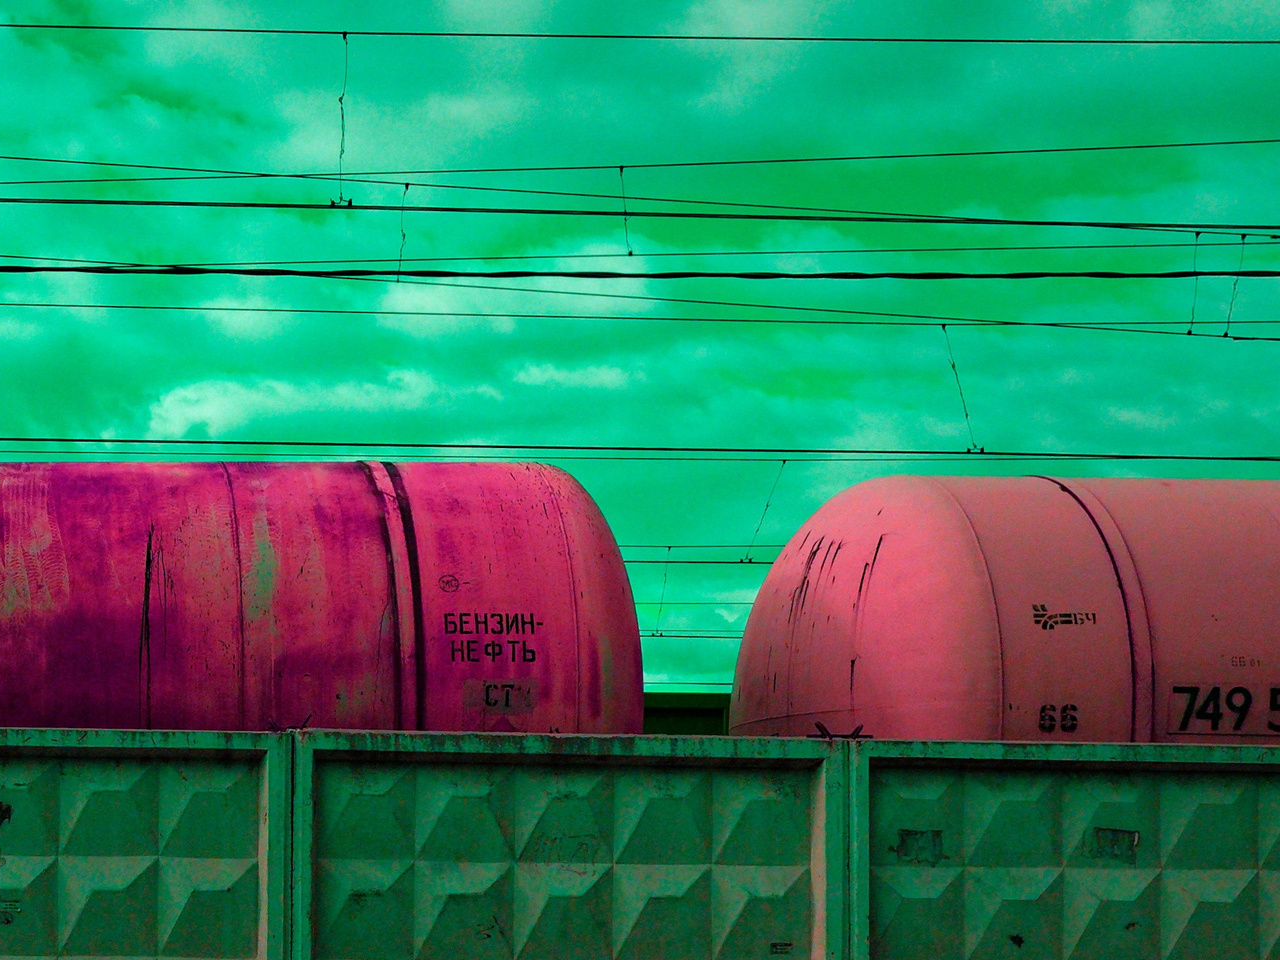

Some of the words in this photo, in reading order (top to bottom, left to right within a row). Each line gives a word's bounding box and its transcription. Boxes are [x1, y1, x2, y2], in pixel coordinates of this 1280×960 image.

[444, 612, 544, 635] БЕНЗИН-
[450, 640, 537, 663] НЕФТЬ
[1038, 703, 1079, 733] 66
[1172, 686, 1253, 731] 749
